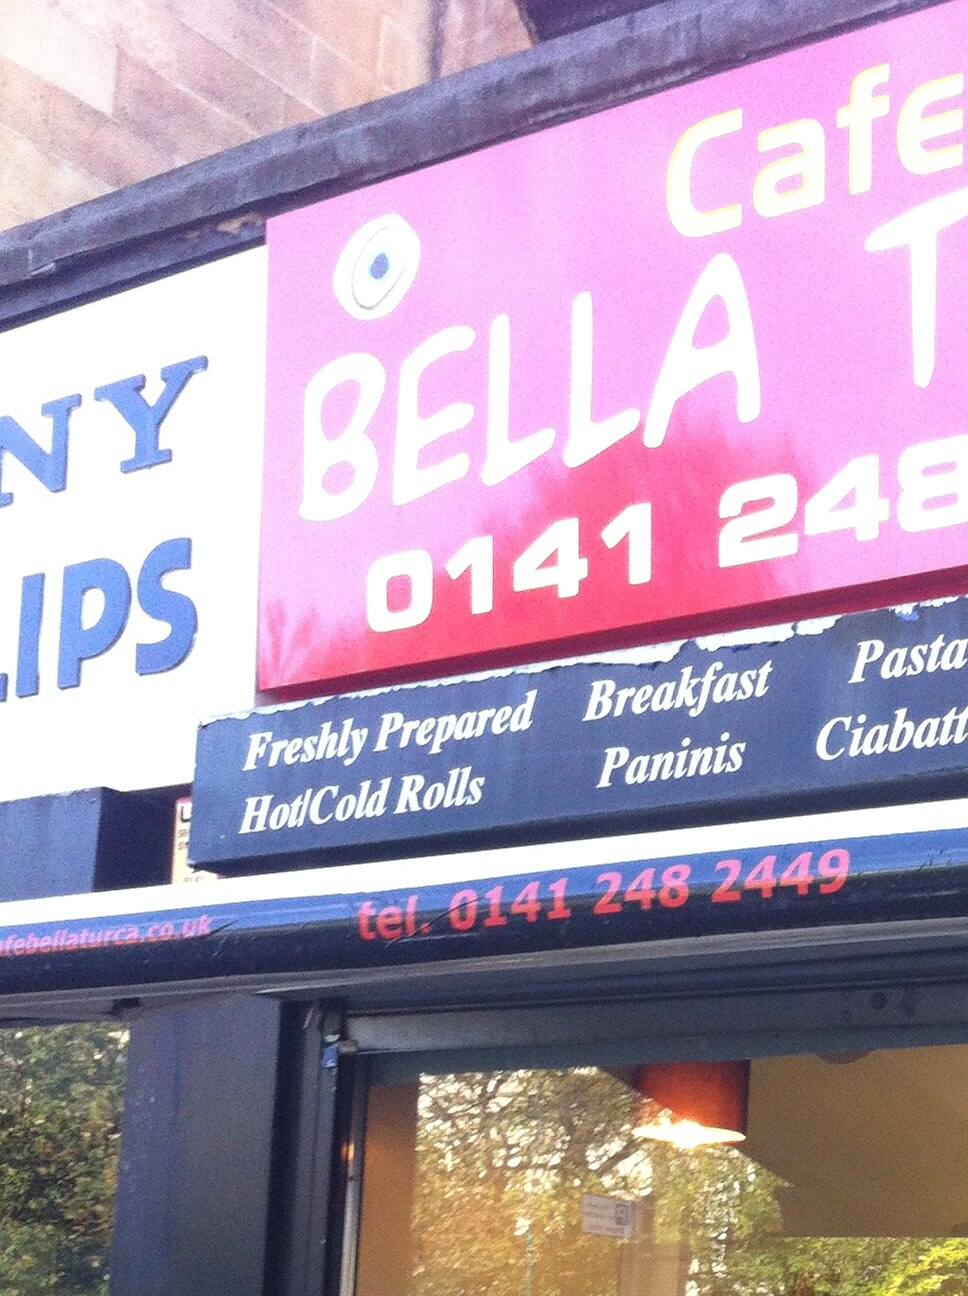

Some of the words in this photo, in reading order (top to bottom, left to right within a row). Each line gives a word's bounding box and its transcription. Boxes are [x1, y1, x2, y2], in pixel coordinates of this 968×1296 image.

[666, 63, 965, 238] Cafe
[299, 253, 761, 522] BELLA
[366, 502, 652, 633] 0141
[0, 537, 198, 702] IPS
[848, 635, 968, 684] Pasta
[242, 722, 368, 771] Freshly
[374, 689, 539, 755] Prepared
[583, 659, 773, 721] Breakfast
[394, 766, 486, 815] Rolls
[597, 732, 746, 788] Paninis
[356, 894, 432, 942] tel.
[449, 877, 572, 933] 0141
[592, 863, 692, 917] 248
[712, 848, 852, 903] 2449
